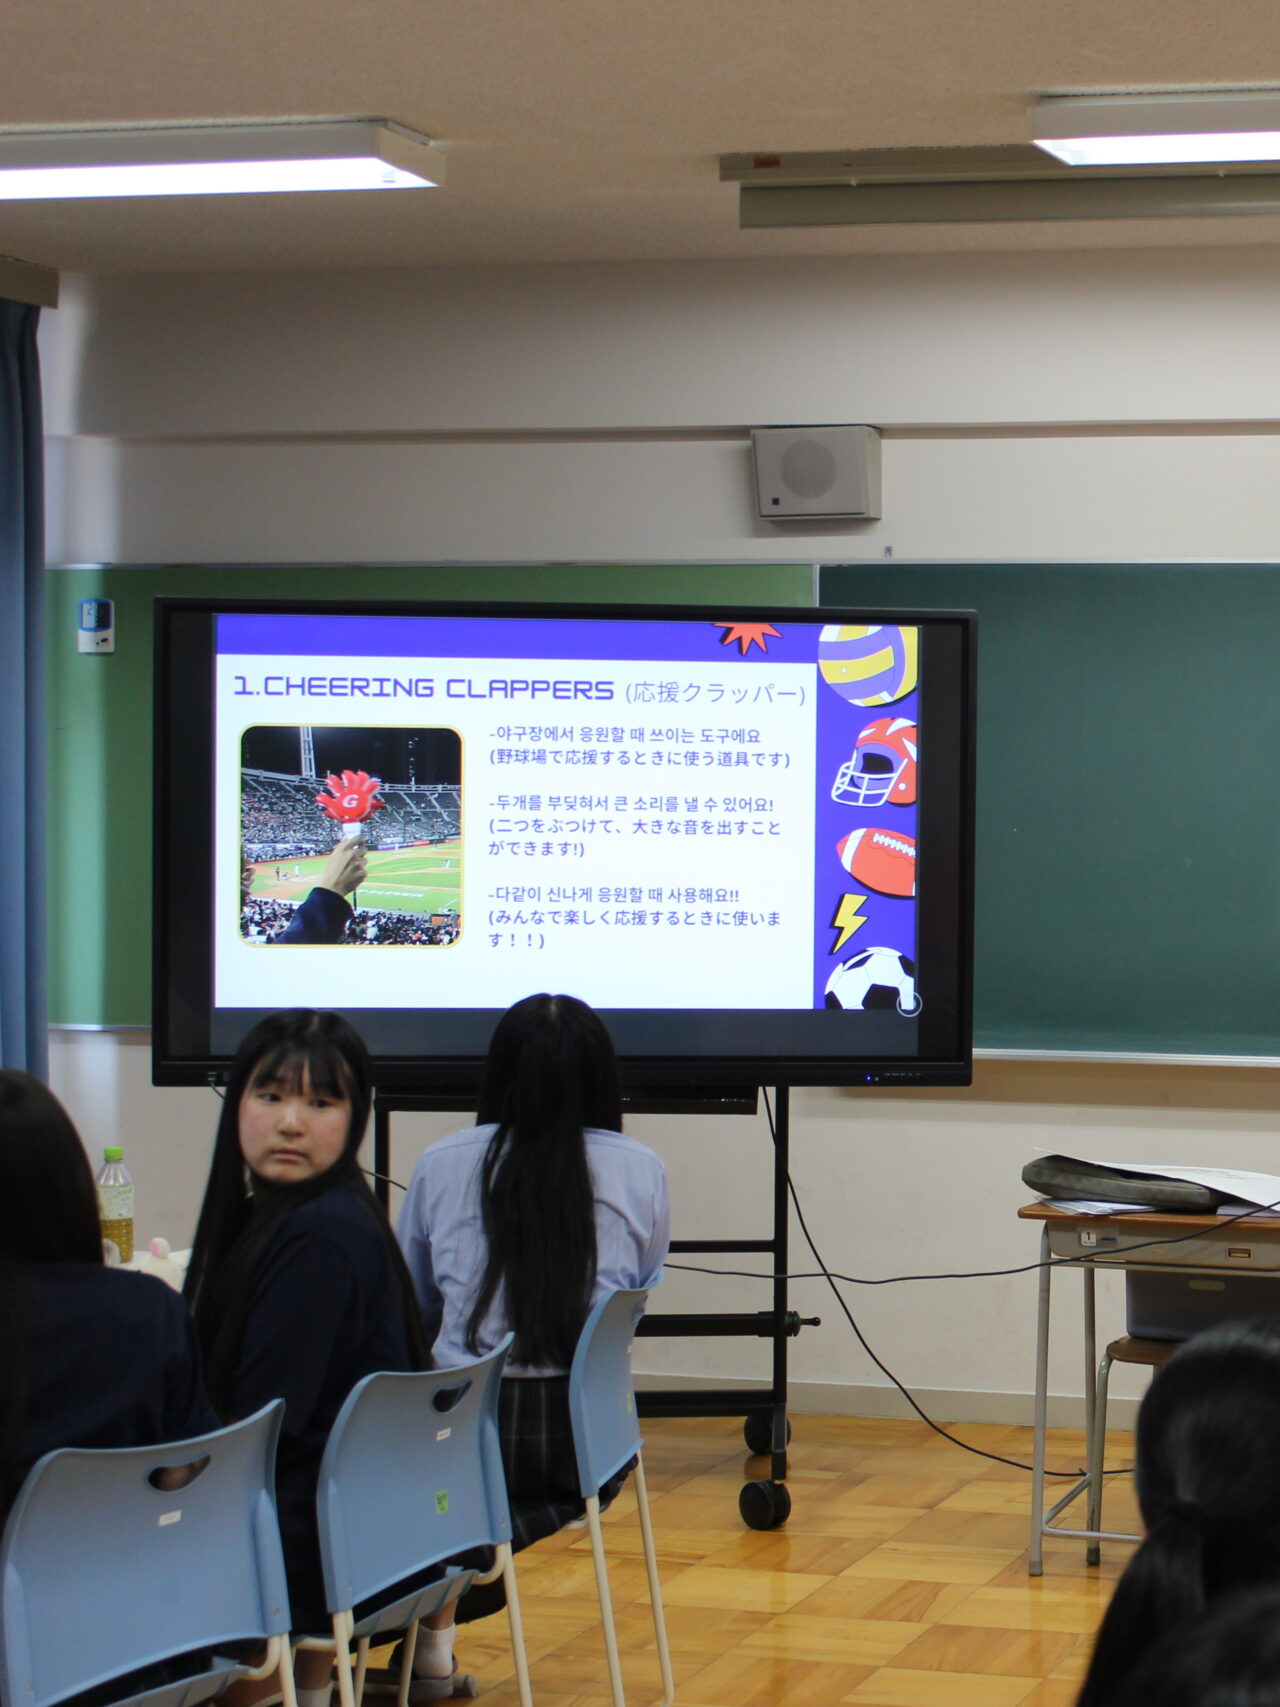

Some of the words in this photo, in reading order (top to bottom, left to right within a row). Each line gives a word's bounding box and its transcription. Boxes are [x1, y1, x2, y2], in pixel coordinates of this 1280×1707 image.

[234, 676, 434, 698] 1.CHEERING
[446, 679, 615, 701] CLAPPERS
[625, 681, 806, 706] (応援クラッパー)
[489, 726, 575, 743] -야구장에서
[580, 726, 626, 743] 응원할
[630, 727, 645, 743] 때
[649, 728, 695, 744] 쓰이는
[700, 728, 762, 744] 도구에요
[489, 749, 790, 768] (野球場で応援するときに使う道具です)
[342, 794, 359, 808] G
[489, 795, 542, 812] -두개를
[614, 796, 629, 811] 큰
[633, 796, 679, 812] 소리를
[684, 796, 699, 813] 낼
[703, 796, 718, 812] 수
[722, 797, 774, 813] 있어요!
[489, 818, 781, 836] (二つをぶつけて、大きな音を出すこと
[488, 841, 585, 858] ができます!)
[488, 886, 541, 903] -다같이
[547, 886, 592, 903] 신나게
[597, 886, 643, 903] 응원할
[648, 887, 662, 903] 때
[667, 887, 739, 904] 사용해요!!
[488, 909, 781, 927] (みんなで楽しく応援するときに使いま
